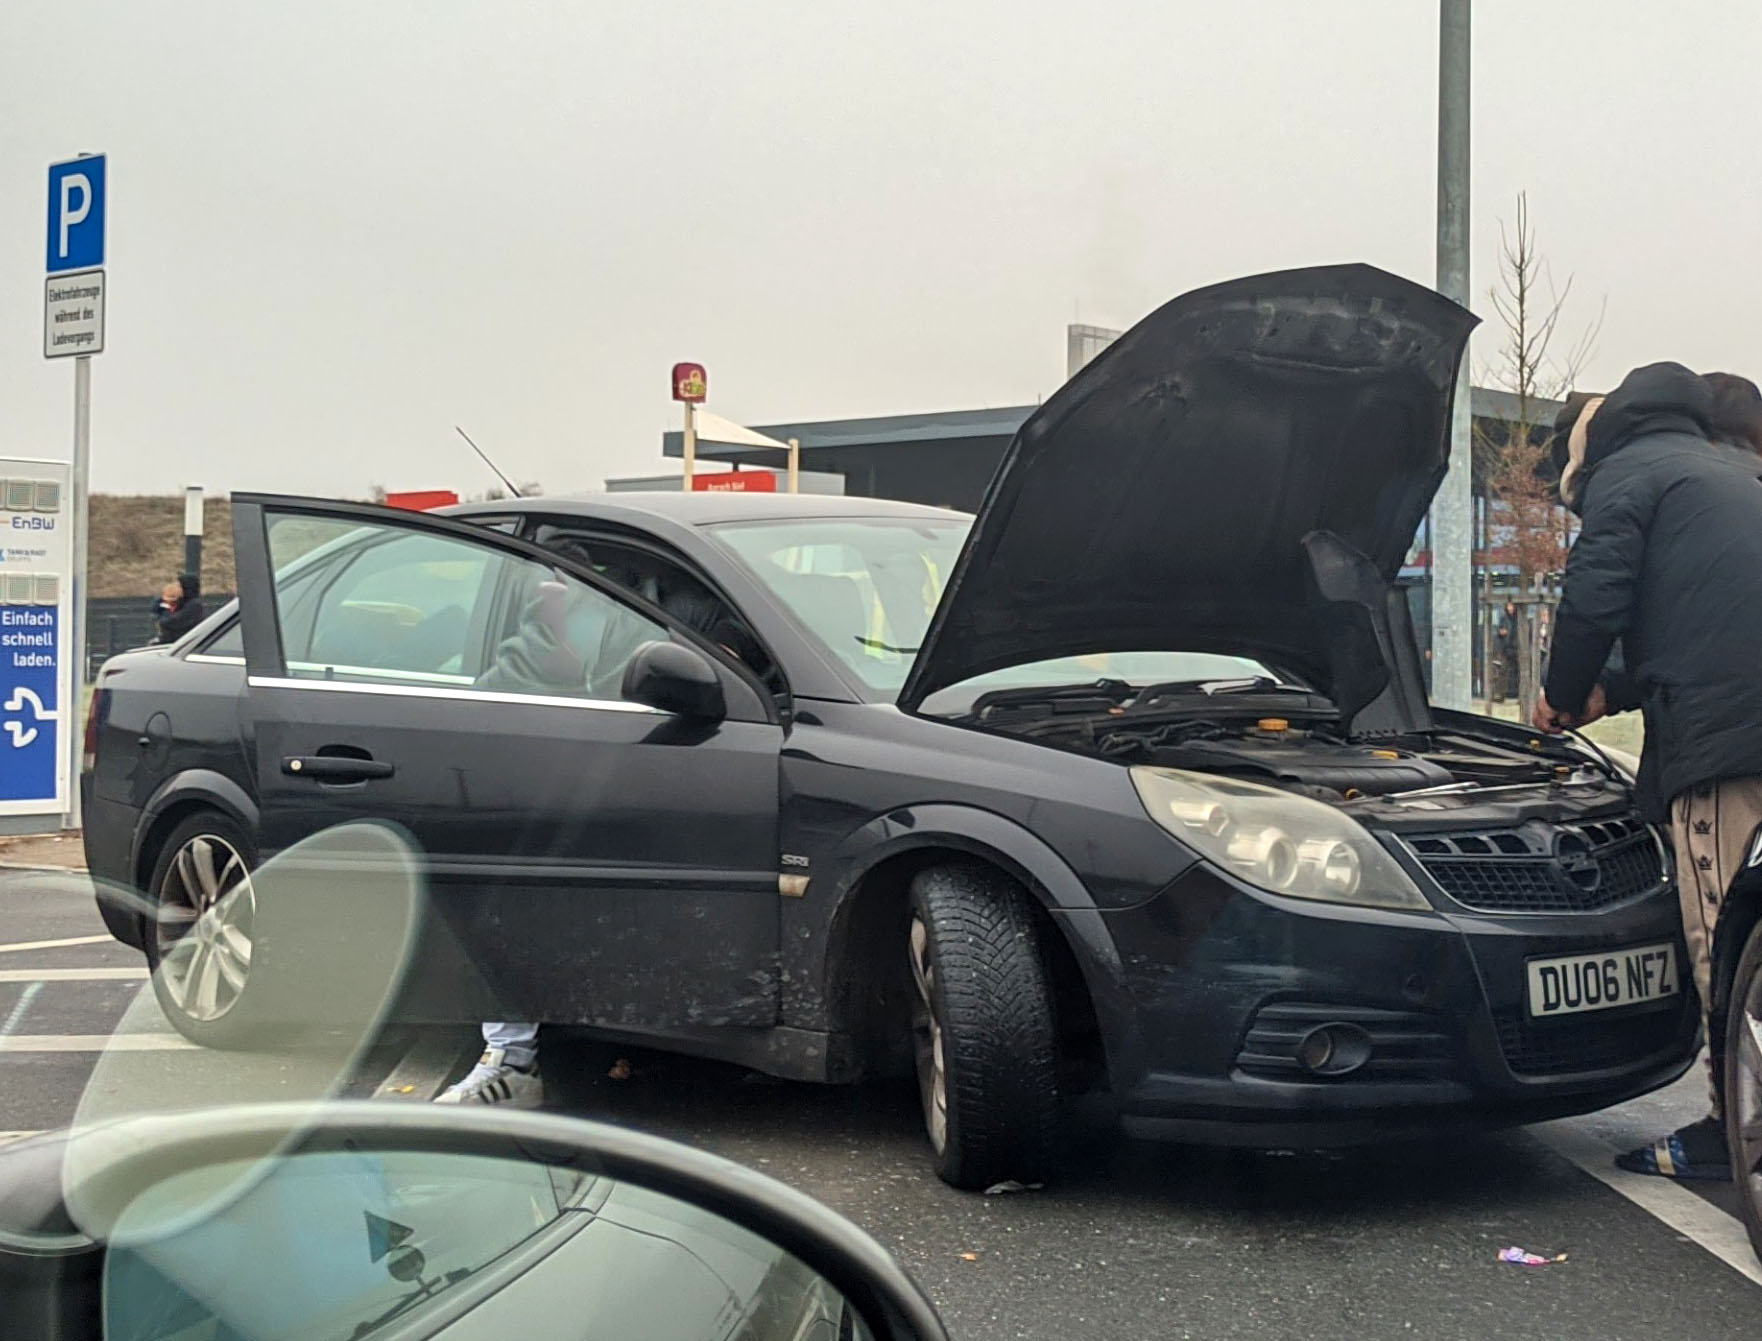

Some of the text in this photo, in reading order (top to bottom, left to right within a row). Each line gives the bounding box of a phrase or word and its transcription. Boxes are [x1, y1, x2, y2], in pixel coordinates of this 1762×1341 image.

[59, 173, 92, 258] P
[55, 307, 94, 323] während des
[12, 516, 55, 530] EnBW
[2, 611, 53, 626] Einfach
[2, 631, 54, 646] schnell
[13, 651, 56, 667] laden.
[1539, 951, 1671, 1011] DU06 NFZ
